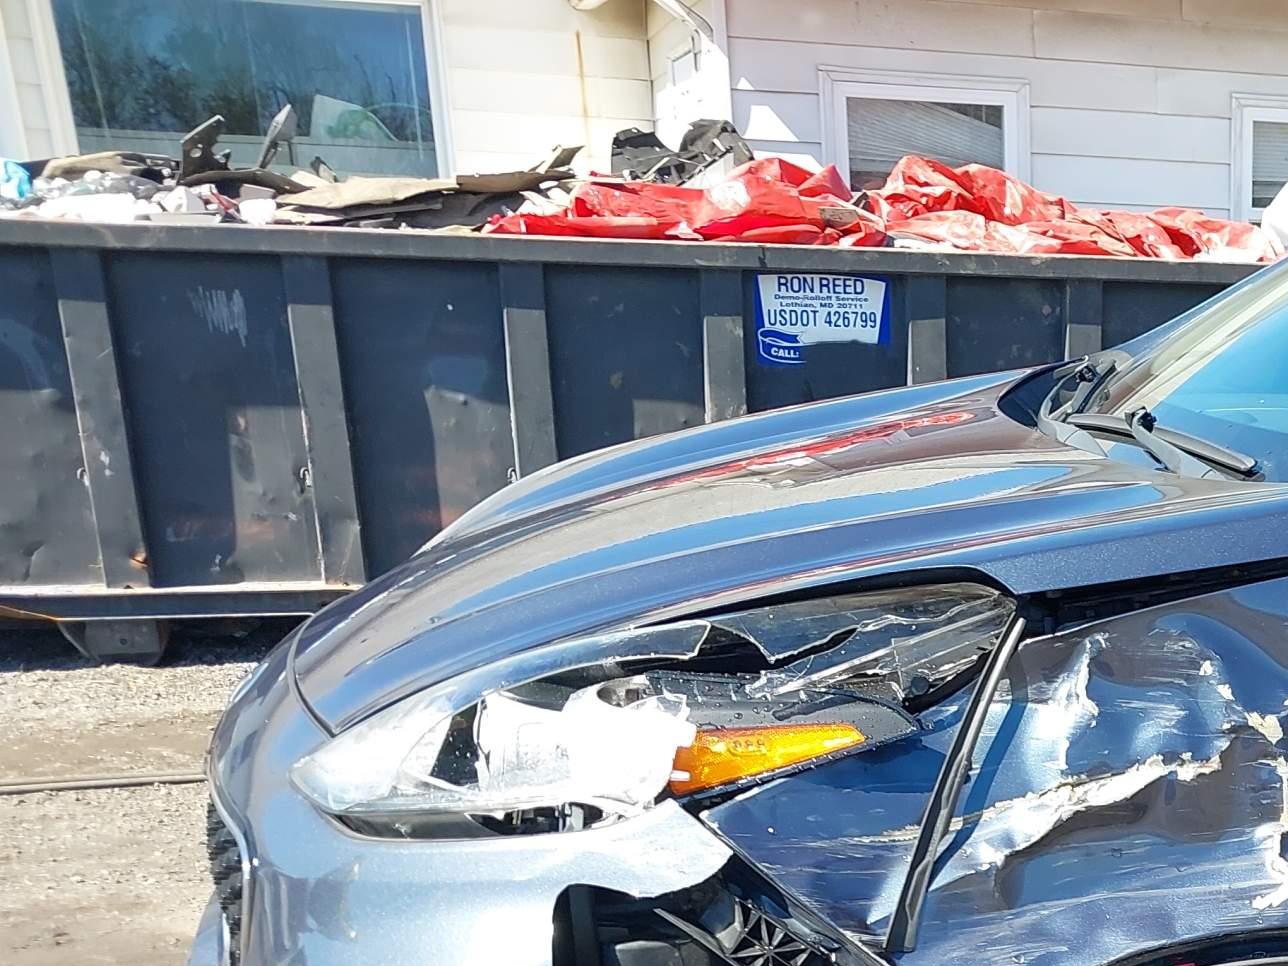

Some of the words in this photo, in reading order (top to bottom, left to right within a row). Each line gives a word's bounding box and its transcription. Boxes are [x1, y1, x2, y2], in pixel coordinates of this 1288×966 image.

[777, 276, 814, 293] RON
[820, 277, 865, 294] REED
[780, 301, 817, 309] Lothian,
[835, 295, 869, 303] Service
[767, 309, 819, 327] USDOT
[824, 311, 877, 328] 426799
[770, 347, 800, 359] CALL:
